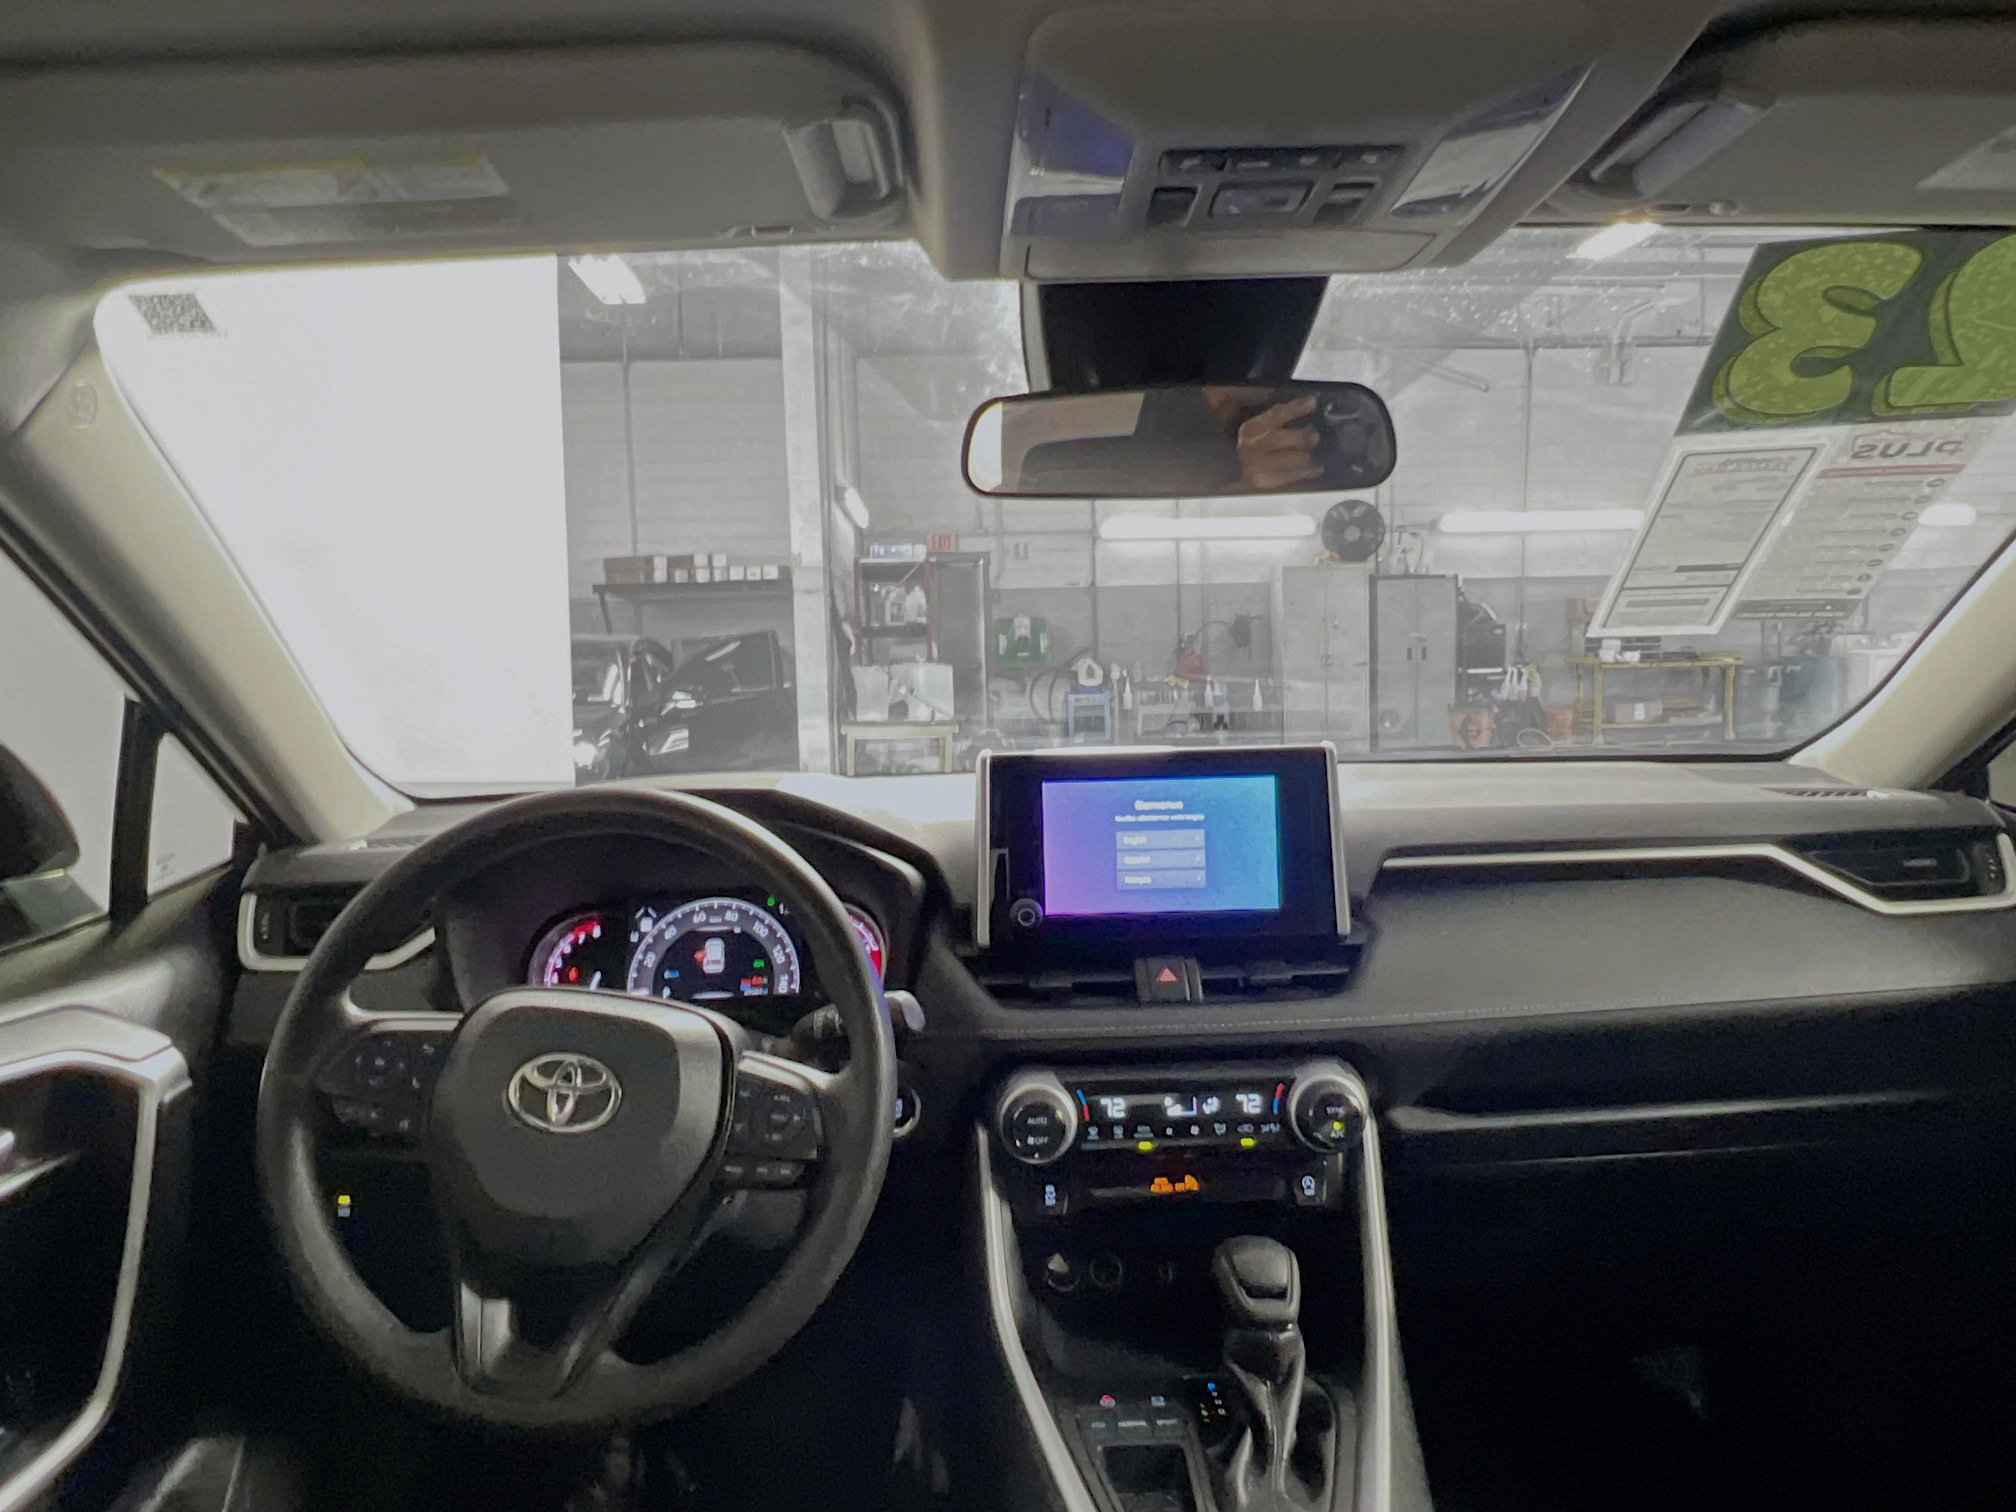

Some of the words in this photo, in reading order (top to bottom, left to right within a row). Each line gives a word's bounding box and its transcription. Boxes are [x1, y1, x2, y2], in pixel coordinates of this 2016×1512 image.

[932, 533, 952, 550] EXIT
[693, 909, 706, 924] 60
[752, 919, 769, 938] 100
[643, 950, 656, 968] 20
[772, 944, 785, 964] 120
[1100, 1097, 1125, 1118] 72
[1235, 1093, 1261, 1115] 72
[1027, 1116, 1048, 1125] AUTO
